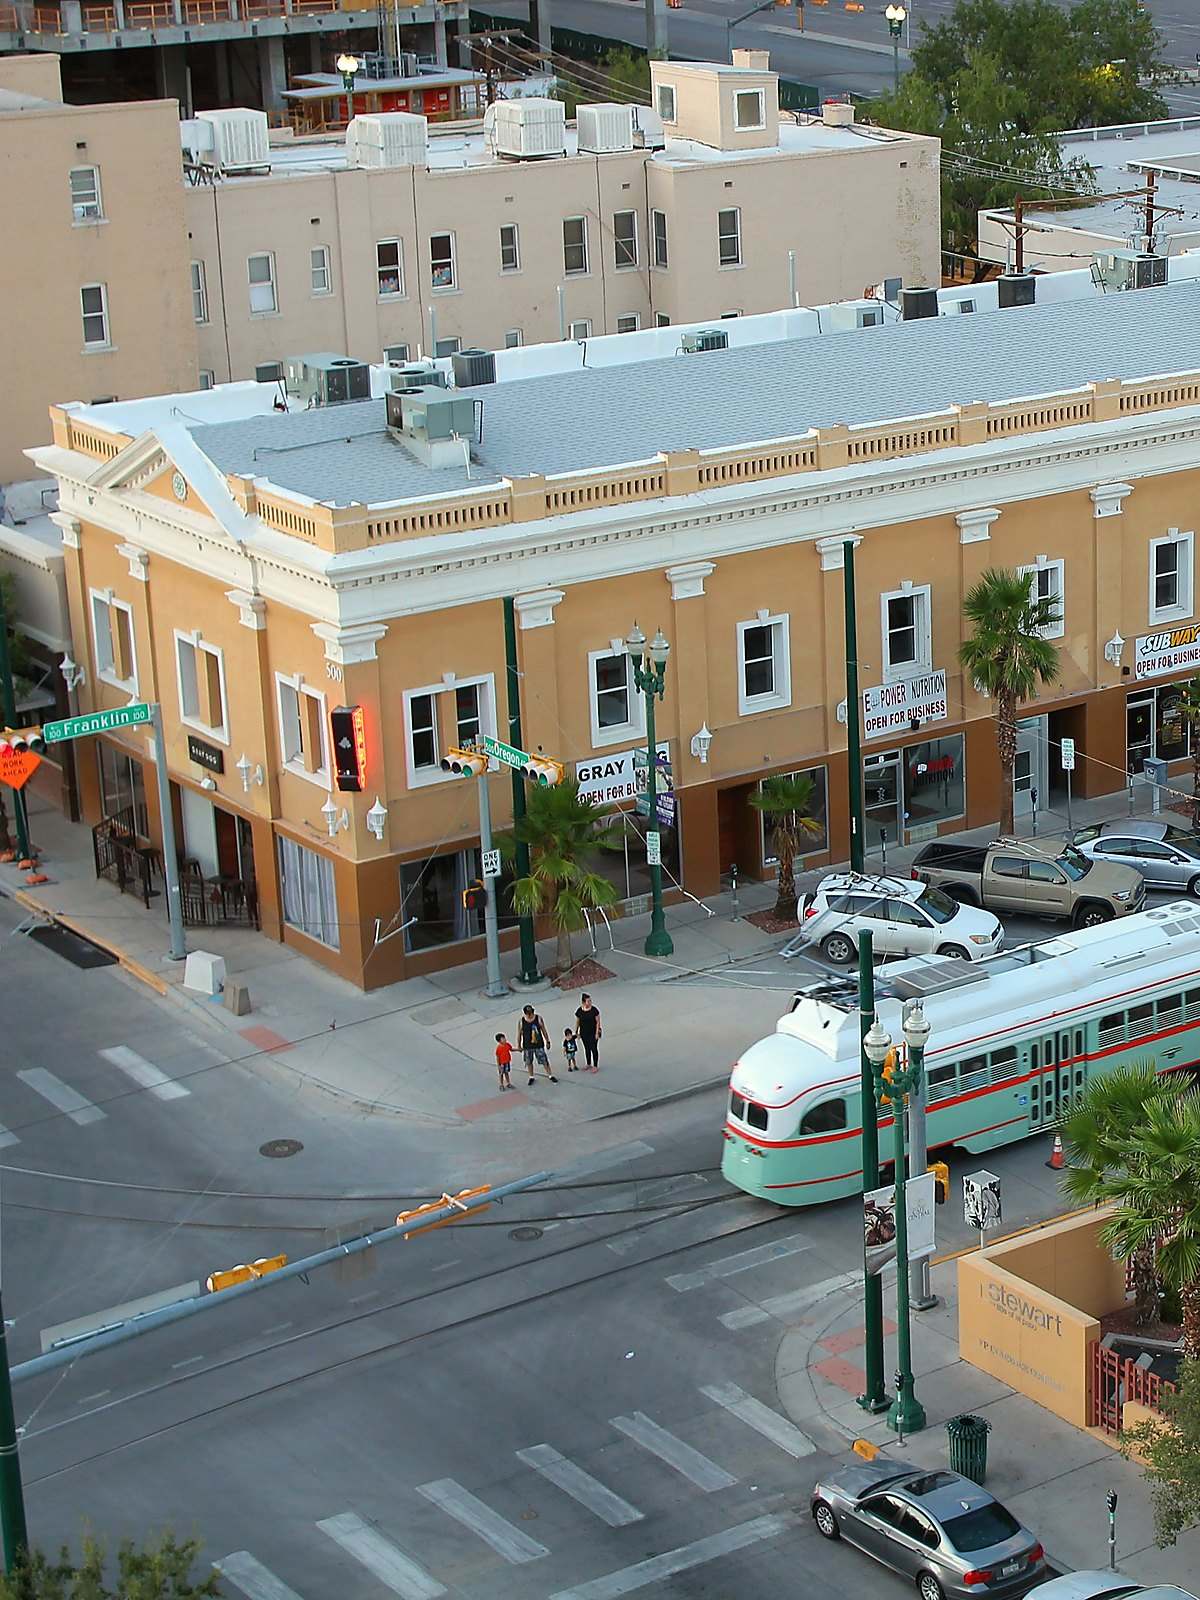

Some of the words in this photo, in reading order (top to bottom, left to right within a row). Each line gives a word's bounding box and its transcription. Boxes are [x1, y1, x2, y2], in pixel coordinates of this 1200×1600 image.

[326, 664, 342, 682] 500
[1136, 656, 1156, 673] OPEN
[1158, 654, 1172, 668] FOR
[880, 684, 907, 708] POWER
[910, 674, 945, 699] NUTRITION
[49, 730, 61, 740] 100
[64, 712, 129, 736] Franklin
[133, 710, 145, 720] 100
[866, 714, 888, 732] OPEN
[890, 711, 906, 726] FOR
[907, 700, 945, 720] BUSINESS
[494, 744, 520, 765] Oregon
[578, 760, 625, 782] GRAY
[606, 785, 624, 799] FOR
[484, 852, 498, 862] ONE
[484, 858, 499, 868] WAY
